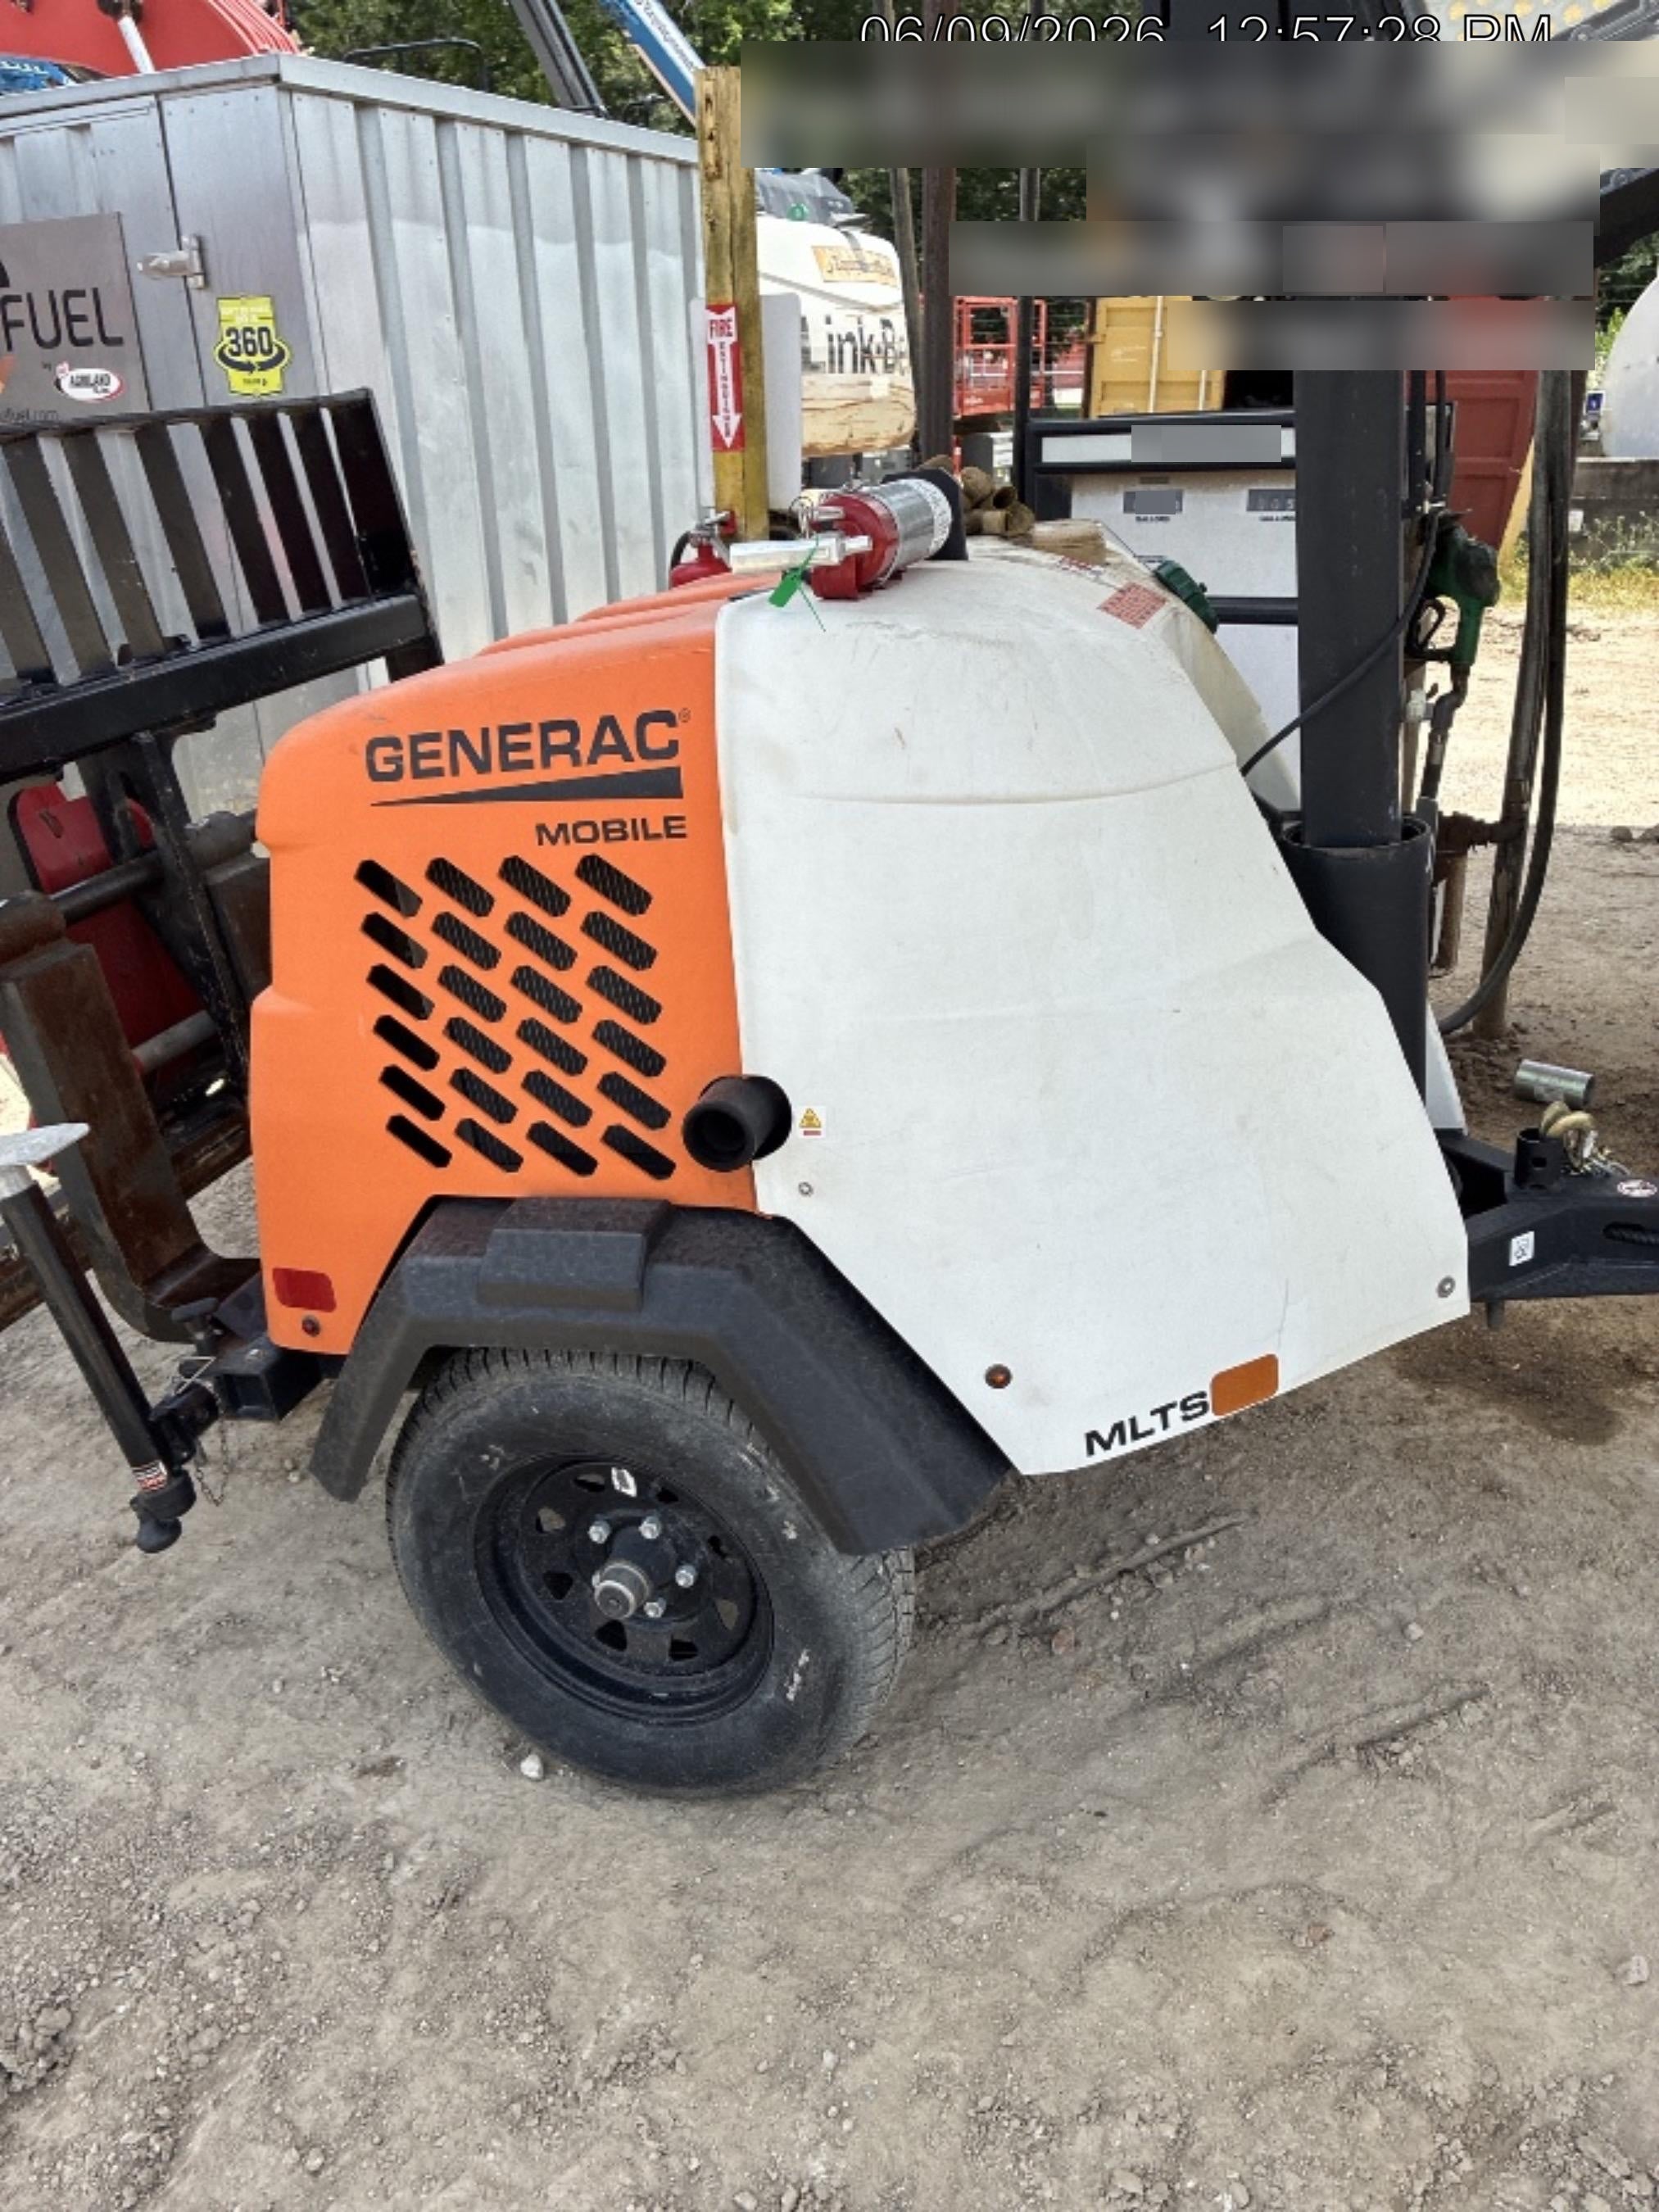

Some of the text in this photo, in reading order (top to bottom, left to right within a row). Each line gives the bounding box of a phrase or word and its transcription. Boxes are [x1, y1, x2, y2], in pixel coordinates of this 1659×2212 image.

[1, 288, 124, 351] FUEL
[225, 325, 274, 357] 360
[709, 319, 733, 338] FIRE
[365, 709, 679, 782] GENERAC
[535, 815, 688, 846] MOBILE
[1085, 1390, 1210, 1457] MLTS
